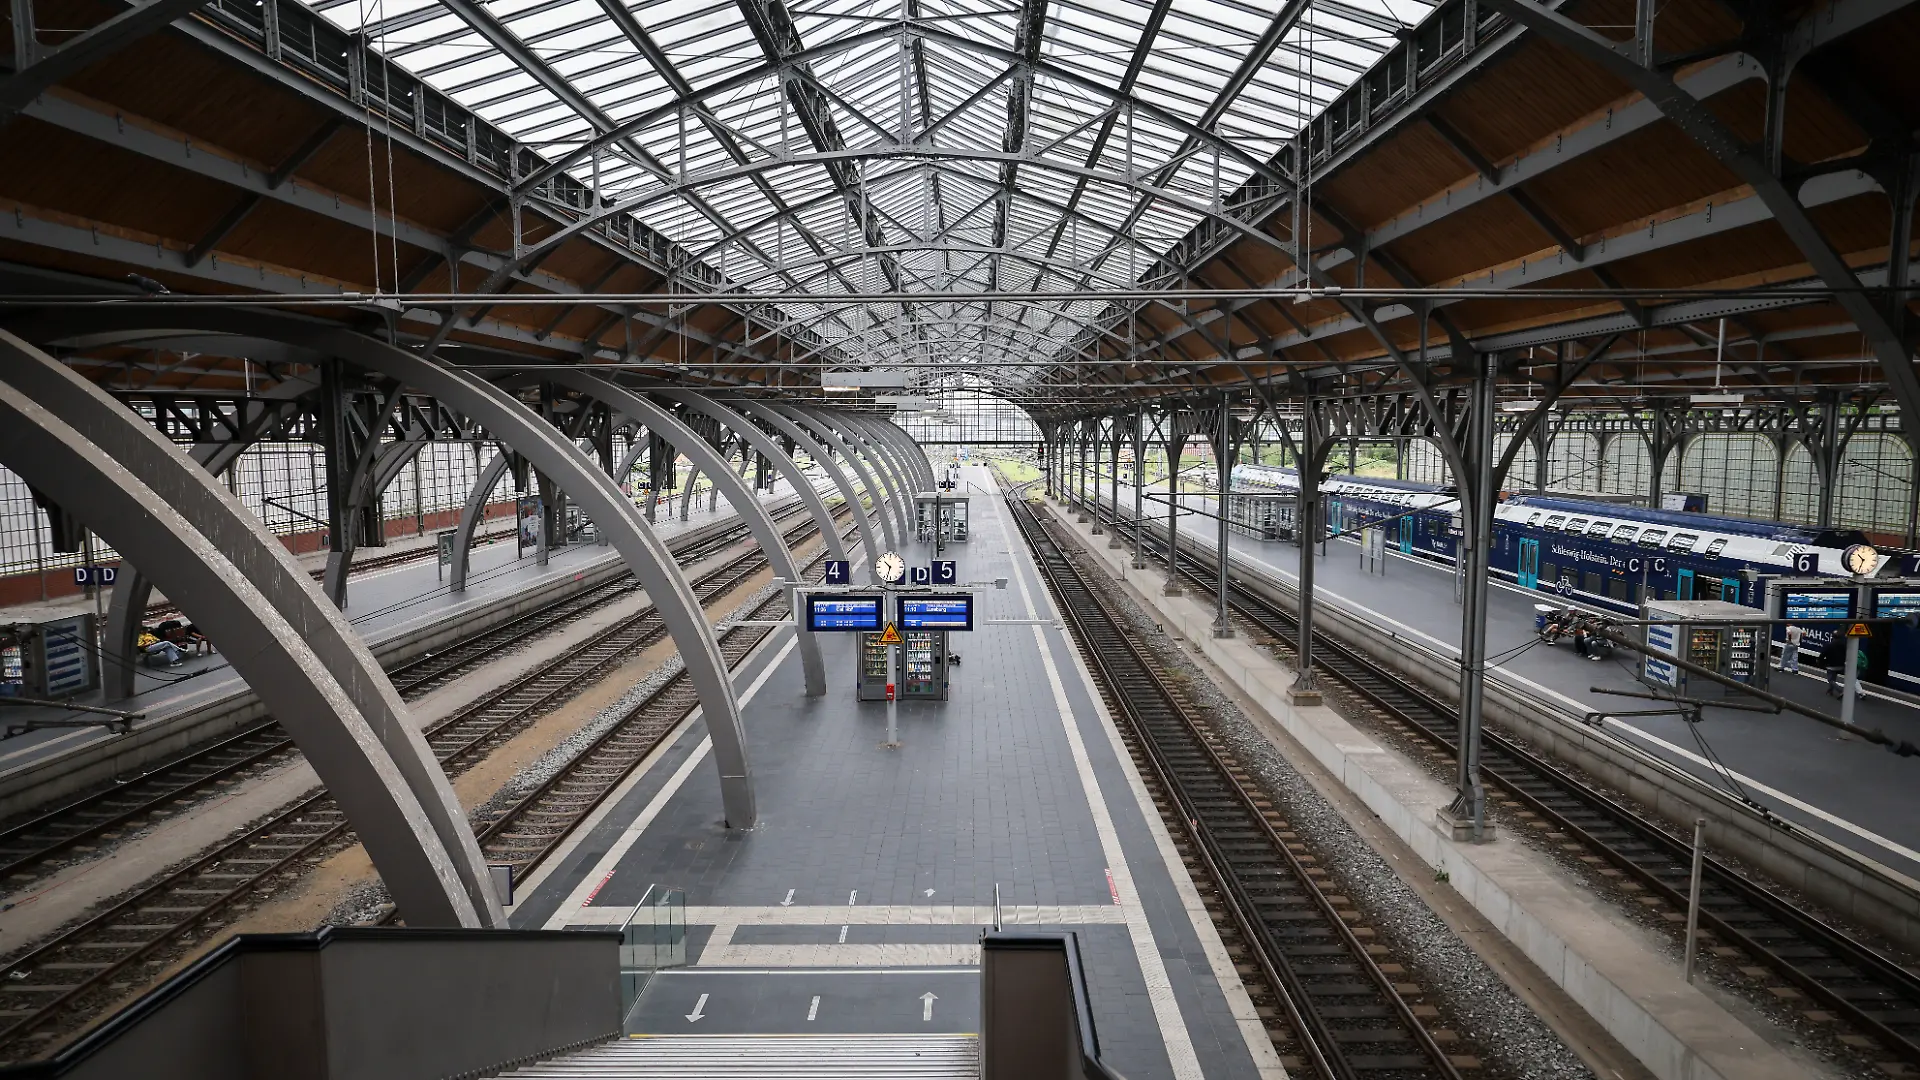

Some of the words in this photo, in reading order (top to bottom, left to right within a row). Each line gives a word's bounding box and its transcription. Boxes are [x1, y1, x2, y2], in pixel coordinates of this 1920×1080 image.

[828, 561, 840, 579] 4
[941, 561, 953, 579] 5
[1629, 558, 1639, 572] C
[1654, 558, 1665, 572] C
[1798, 554, 1810, 572] 6
[76, 568, 87, 582] D
[103, 568, 115, 581] D
[916, 568, 928, 581] D
[1748, 581, 1754, 591] 2
